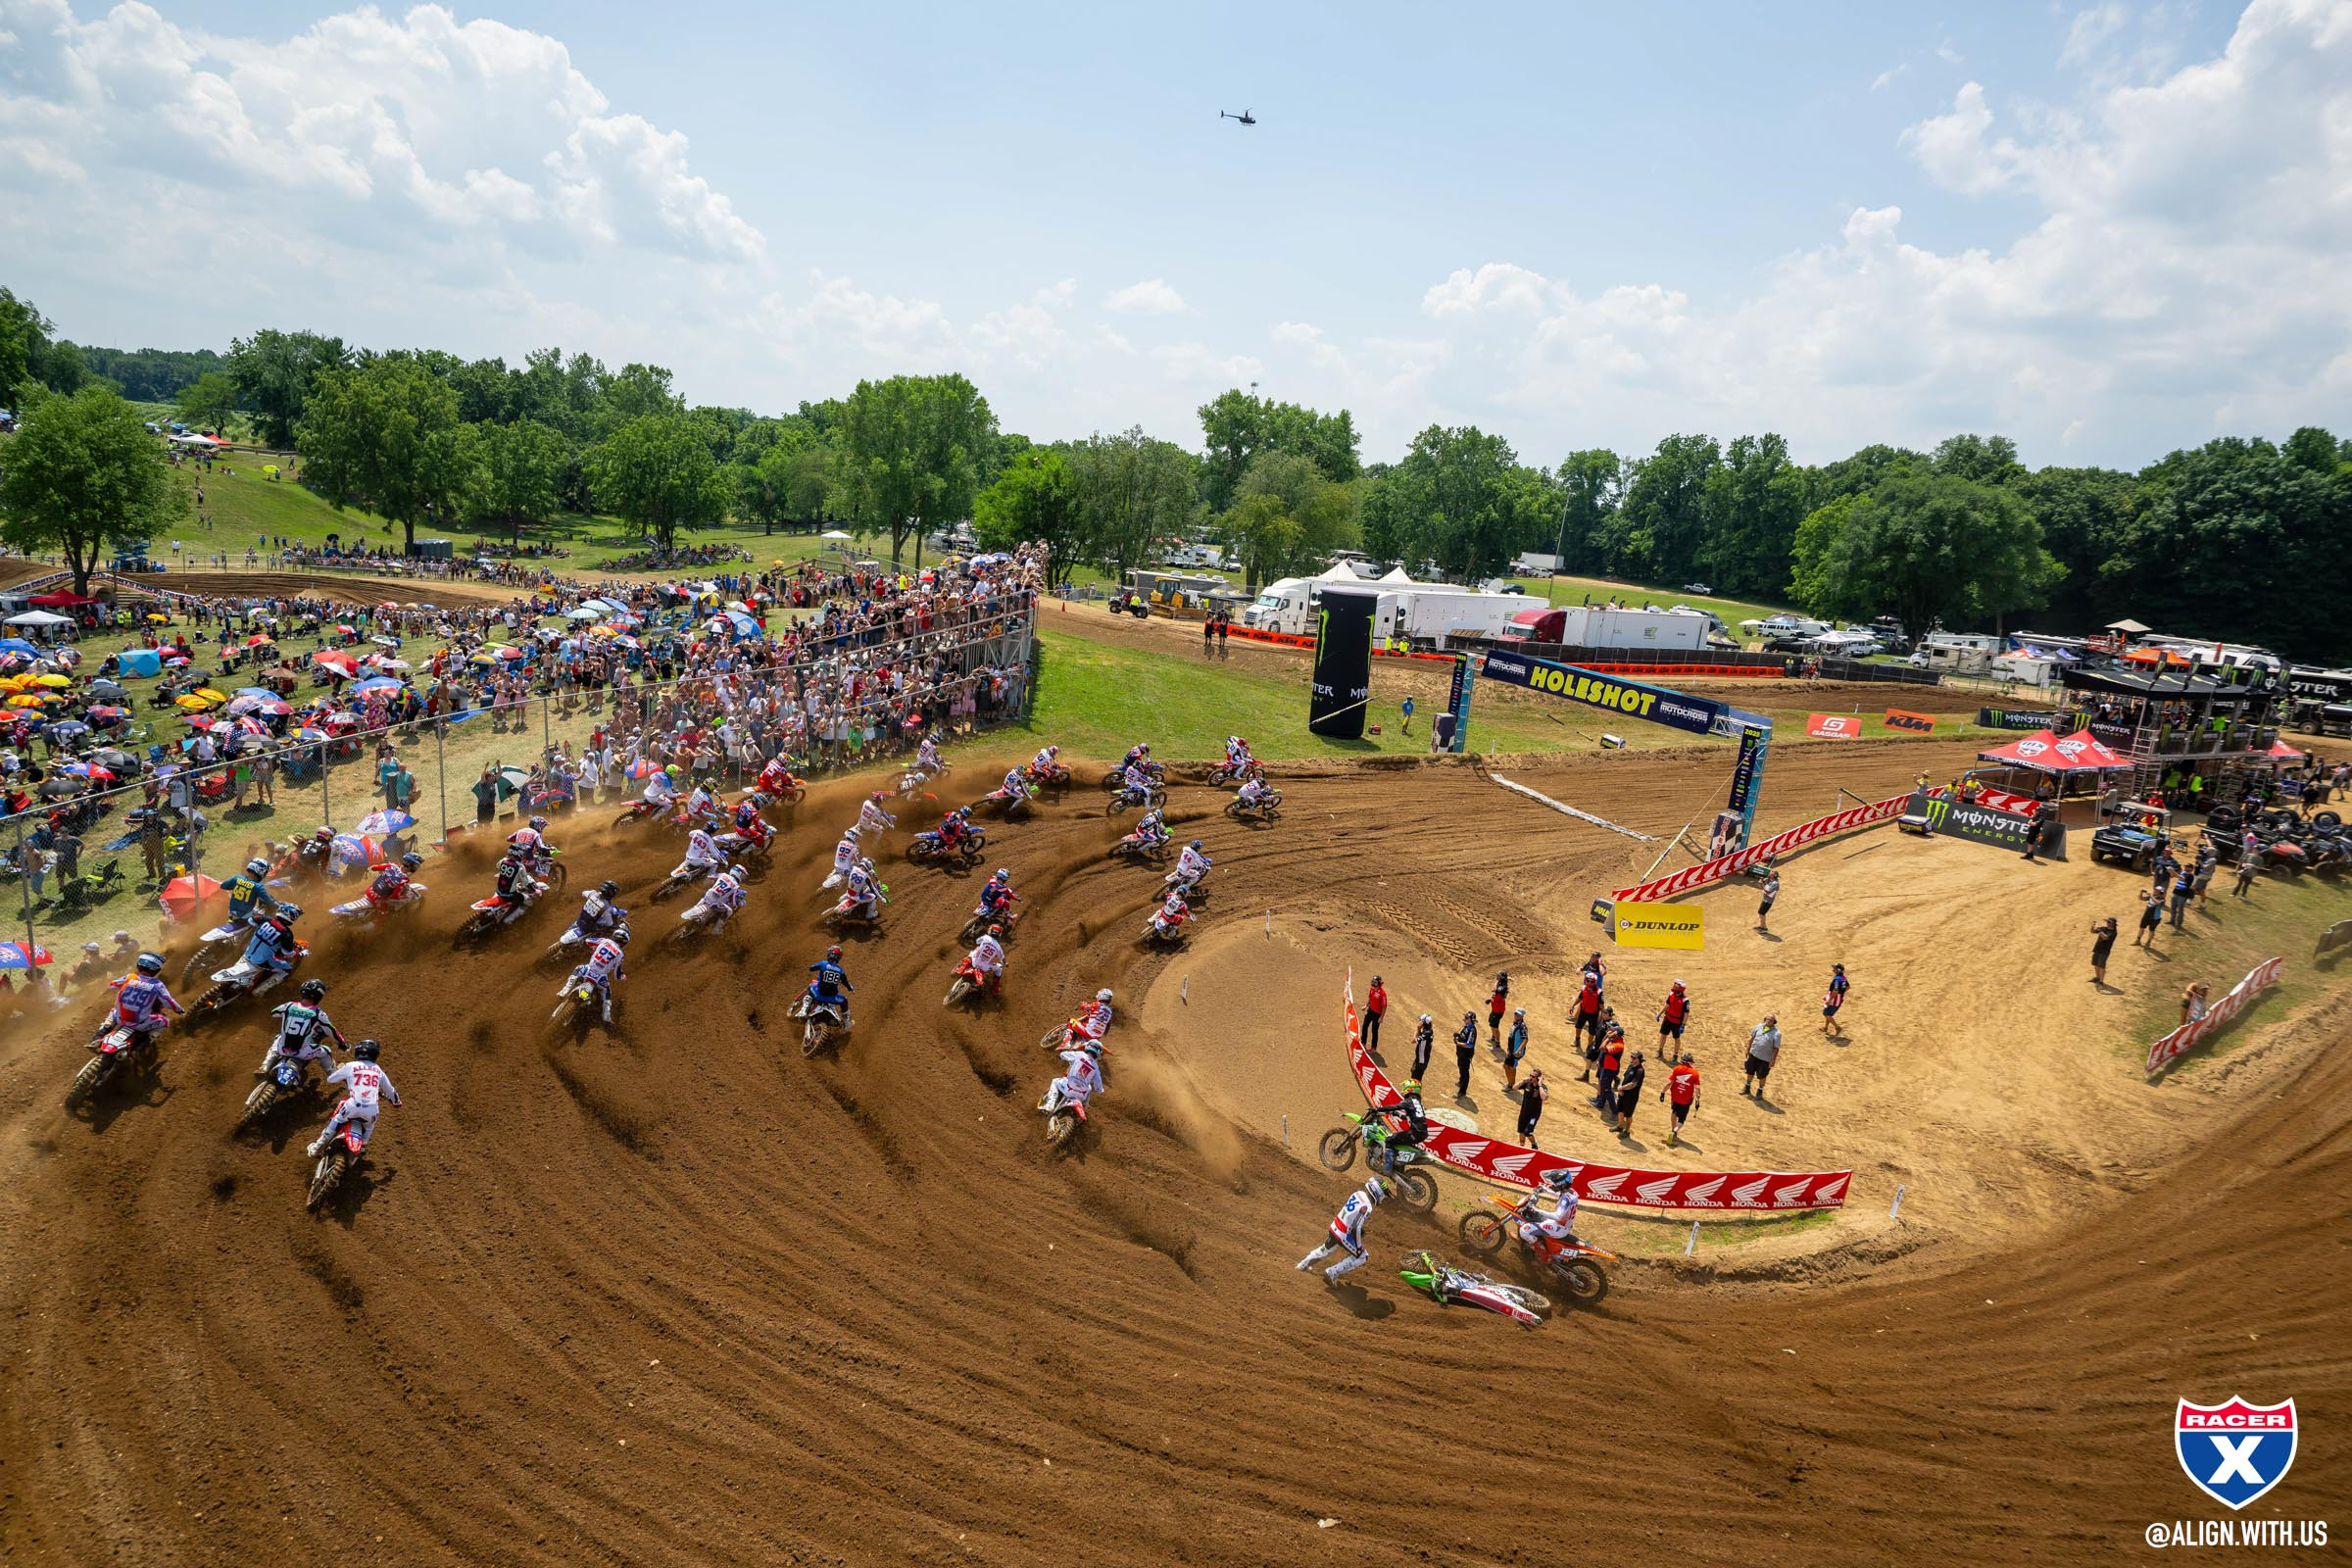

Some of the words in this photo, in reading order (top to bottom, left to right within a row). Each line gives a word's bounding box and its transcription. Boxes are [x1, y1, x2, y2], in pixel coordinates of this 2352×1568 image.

[1530, 666, 1656, 716] HOLESHOT
[1660, 704, 1708, 721] MOTOCROSS
[2005, 713, 2053, 725] MONSTER
[1886, 714, 1934, 732] KTM
[2091, 722, 2131, 735] MONSTER
[1744, 728, 1761, 737] 2025
[1811, 729, 1851, 738] GASGAS
[1952, 808, 2030, 835] MONSTE
[1962, 826, 2028, 844] ENERGY
[500, 863, 515, 878] 99
[851, 872, 863, 885] 98
[258, 921, 281, 942] 991
[1635, 921, 1700, 931] DUNLOP
[982, 945, 996, 956] 25
[121, 986, 151, 1007] 239
[285, 1016, 311, 1036] 151
[353, 1074, 379, 1088] 736
[1445, 1153, 1486, 1173] HONDA
[1490, 1169, 1532, 1186] HONDA
[1586, 1192, 1630, 1202] HONDA
[1635, 1198, 1678, 1206] HONDA
